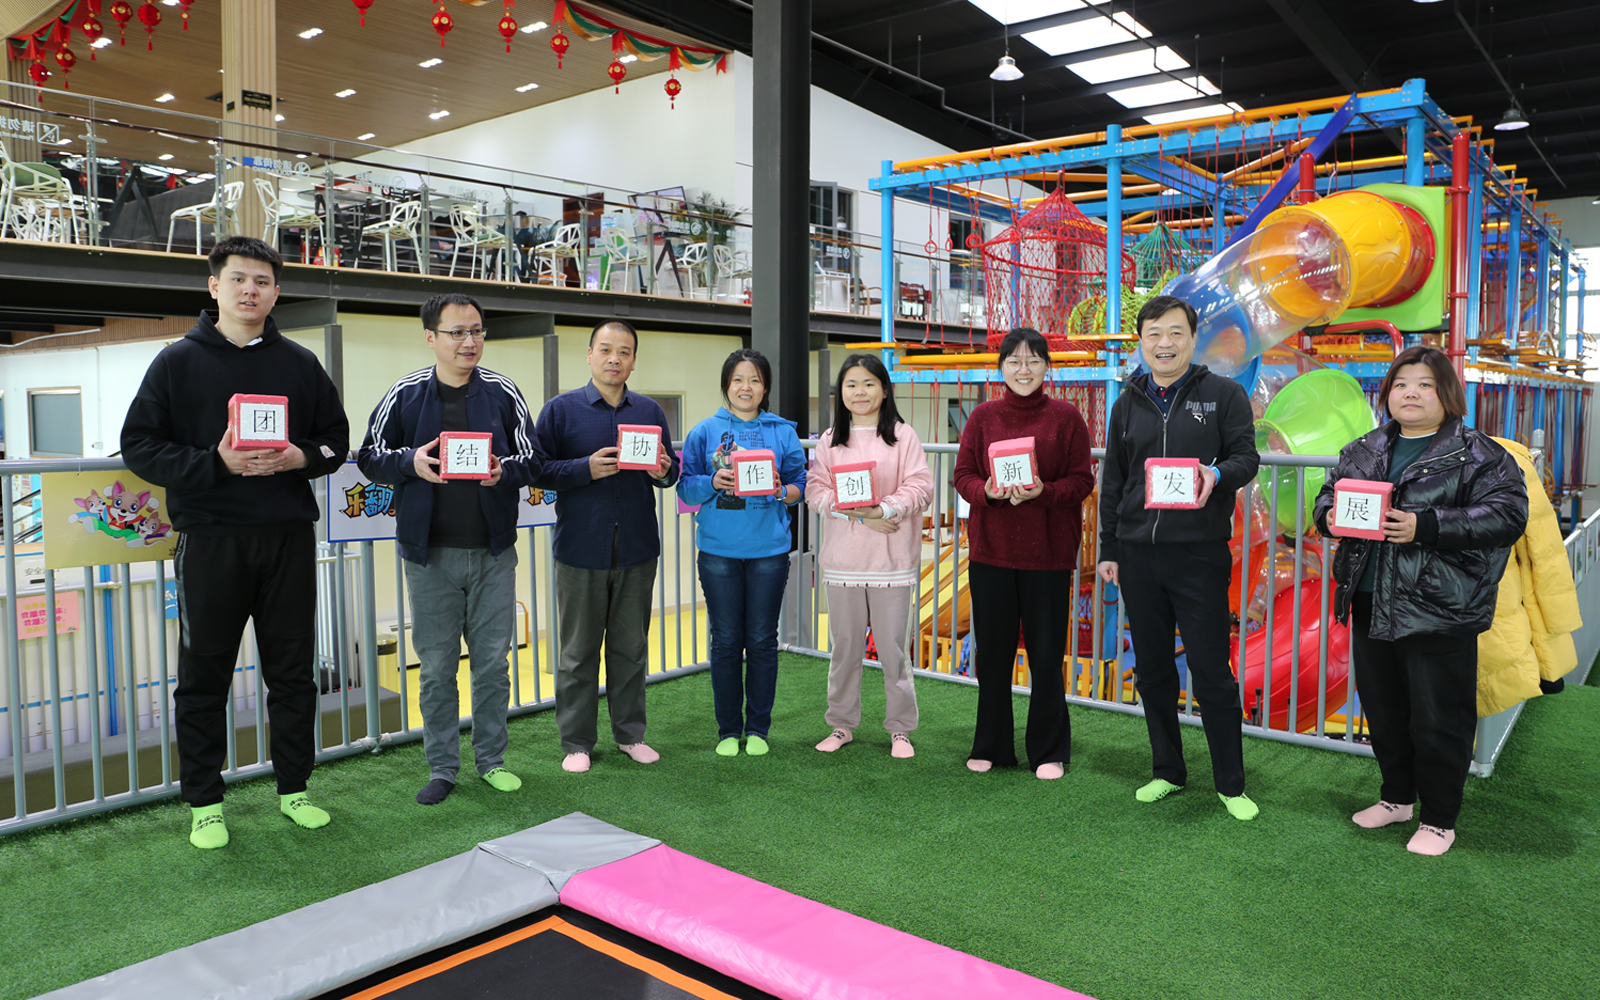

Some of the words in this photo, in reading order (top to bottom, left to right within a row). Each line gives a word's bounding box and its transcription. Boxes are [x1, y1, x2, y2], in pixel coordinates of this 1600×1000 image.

[1185, 400, 1217, 412] PUMA
[254, 410, 276, 433] 团
[456, 443, 479, 466] 结
[631, 436, 651, 457] 协
[745, 464, 764, 485] 作
[1002, 460, 1022, 482] 新
[845, 476, 864, 496] 创
[1163, 472, 1185, 496] 发
[340, 482, 396, 518] 乐翻
[1344, 497, 1369, 521] 展
